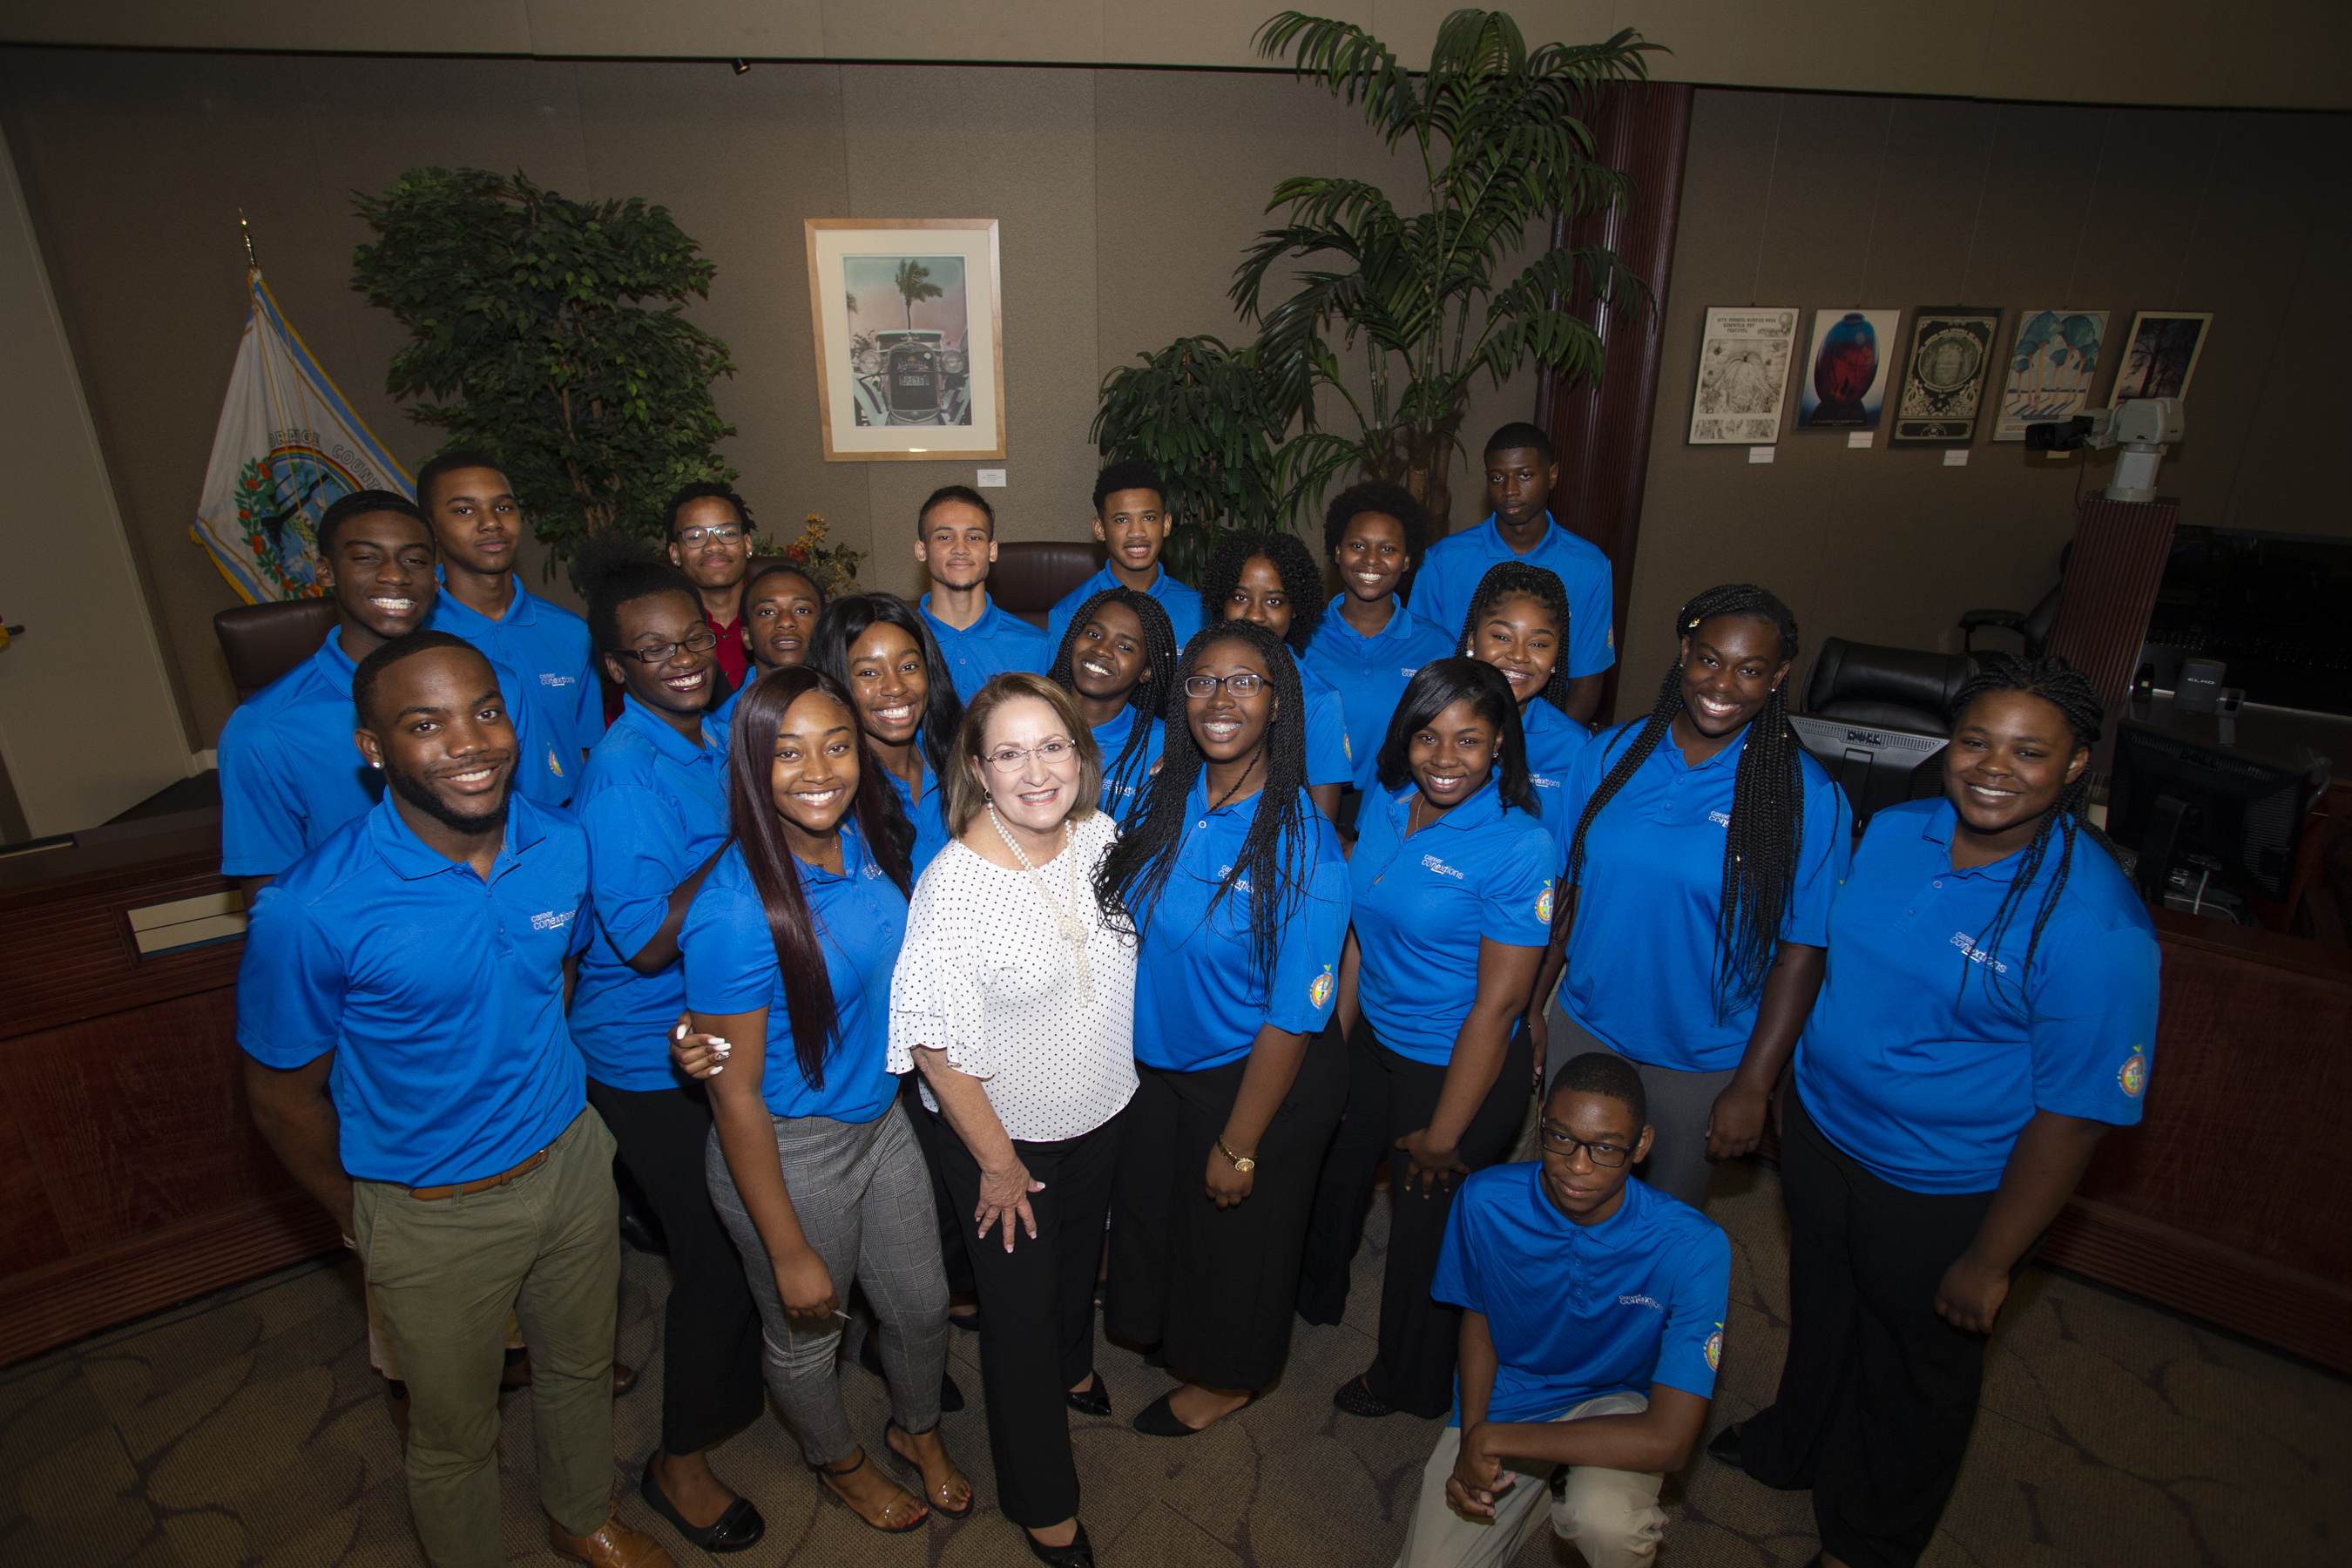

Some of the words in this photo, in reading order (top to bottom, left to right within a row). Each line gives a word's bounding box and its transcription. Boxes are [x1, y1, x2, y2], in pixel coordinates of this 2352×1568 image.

[332, 444, 384, 490] COUNT
[1423, 854, 1443, 864] career
[1421, 859, 1464, 880] conextions
[531, 910, 554, 923] career
